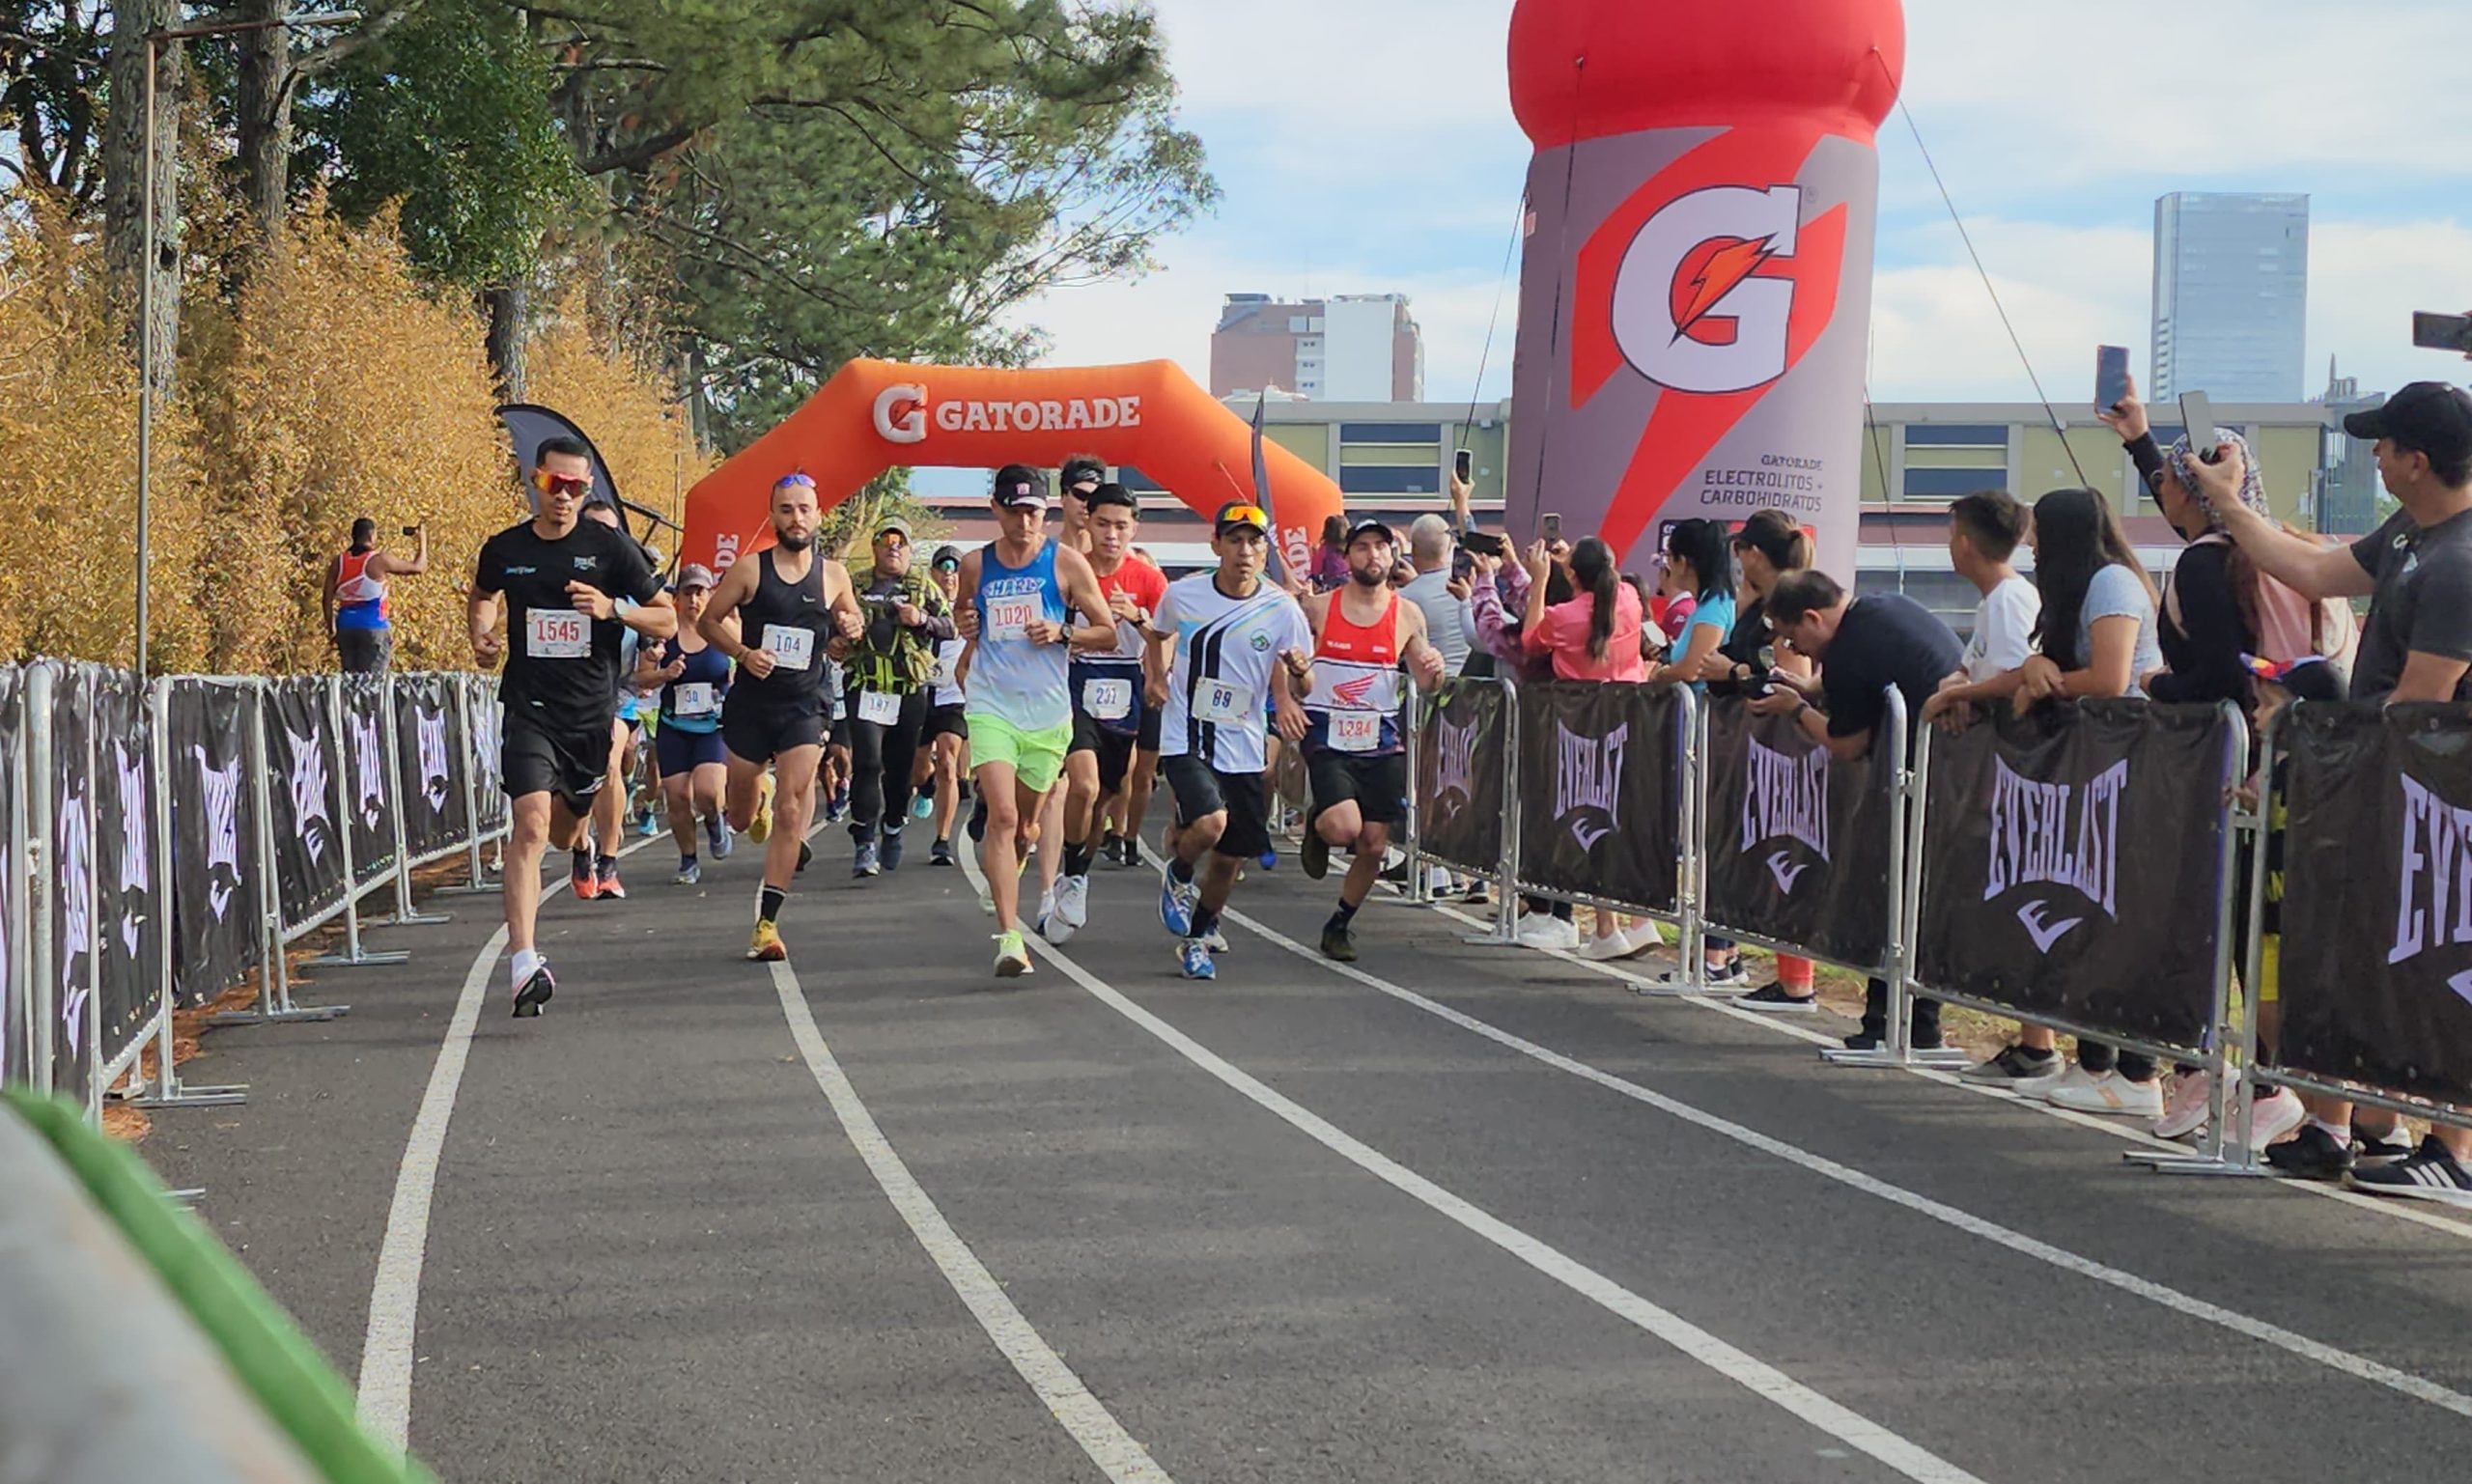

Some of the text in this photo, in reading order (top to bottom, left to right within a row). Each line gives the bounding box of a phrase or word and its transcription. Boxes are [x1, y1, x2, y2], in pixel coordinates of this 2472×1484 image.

[1611, 184, 1802, 394] G
[936, 397, 1140, 432] GATORADE
[1761, 454, 1823, 471] GATORADE
[1705, 469, 1813, 491] ELECTROLITOS
[1700, 490, 1822, 512] CARBOHIDRATOS
[995, 605, 1033, 627] 1020
[536, 619, 579, 641] 1545
[774, 634, 801, 652] 104
[1213, 688, 1232, 708] 89
[1984, 752, 2127, 922] EVERLAST
